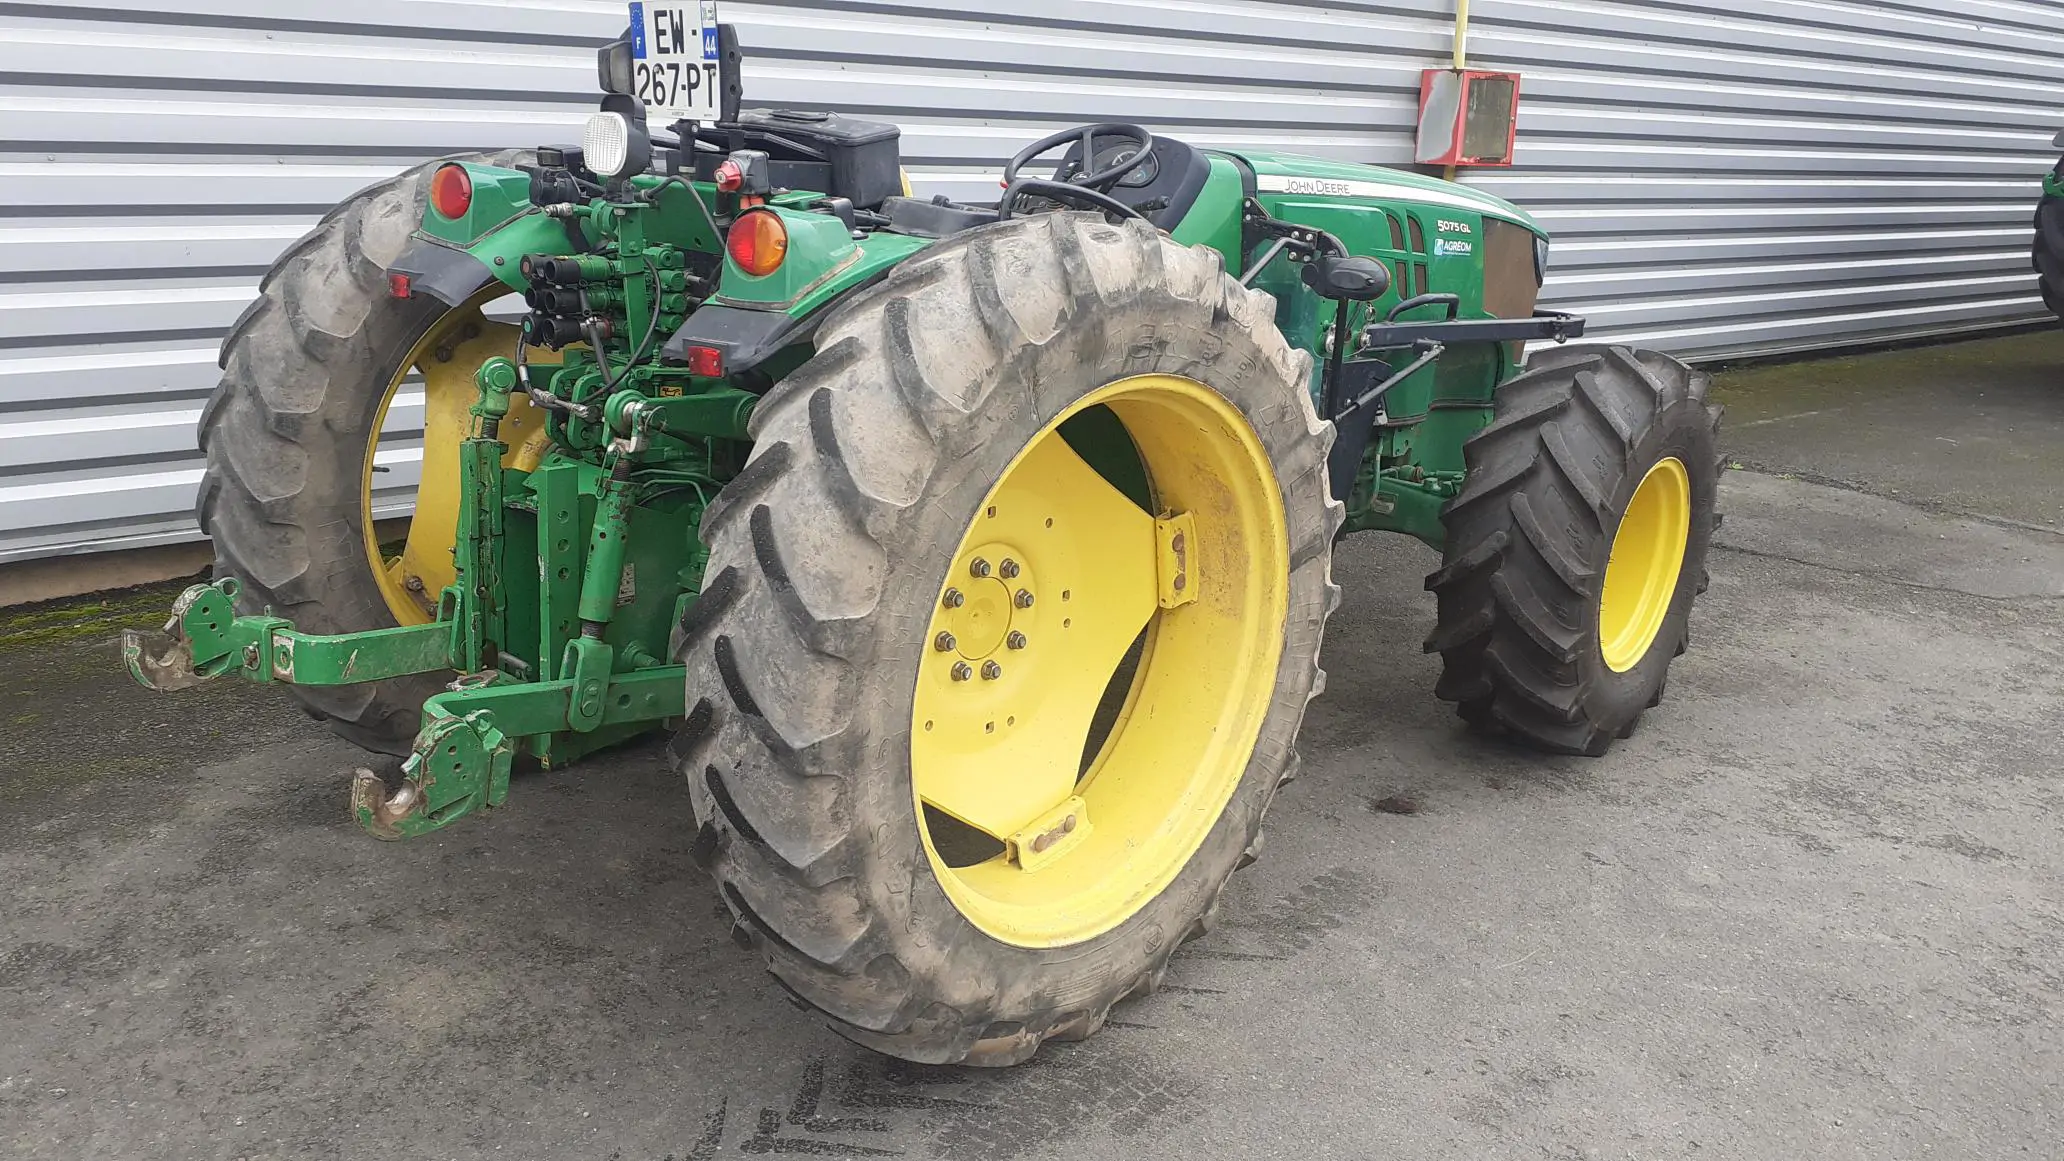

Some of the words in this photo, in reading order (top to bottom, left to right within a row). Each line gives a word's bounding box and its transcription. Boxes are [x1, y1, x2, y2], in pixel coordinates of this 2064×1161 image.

[705, 35, 717, 55] 44
[1285, 179, 1314, 192] JOHN
[1316, 180, 1350, 194] DEERE
[1437, 219, 1460, 232] 5075
[1460, 223, 1472, 234] GL
